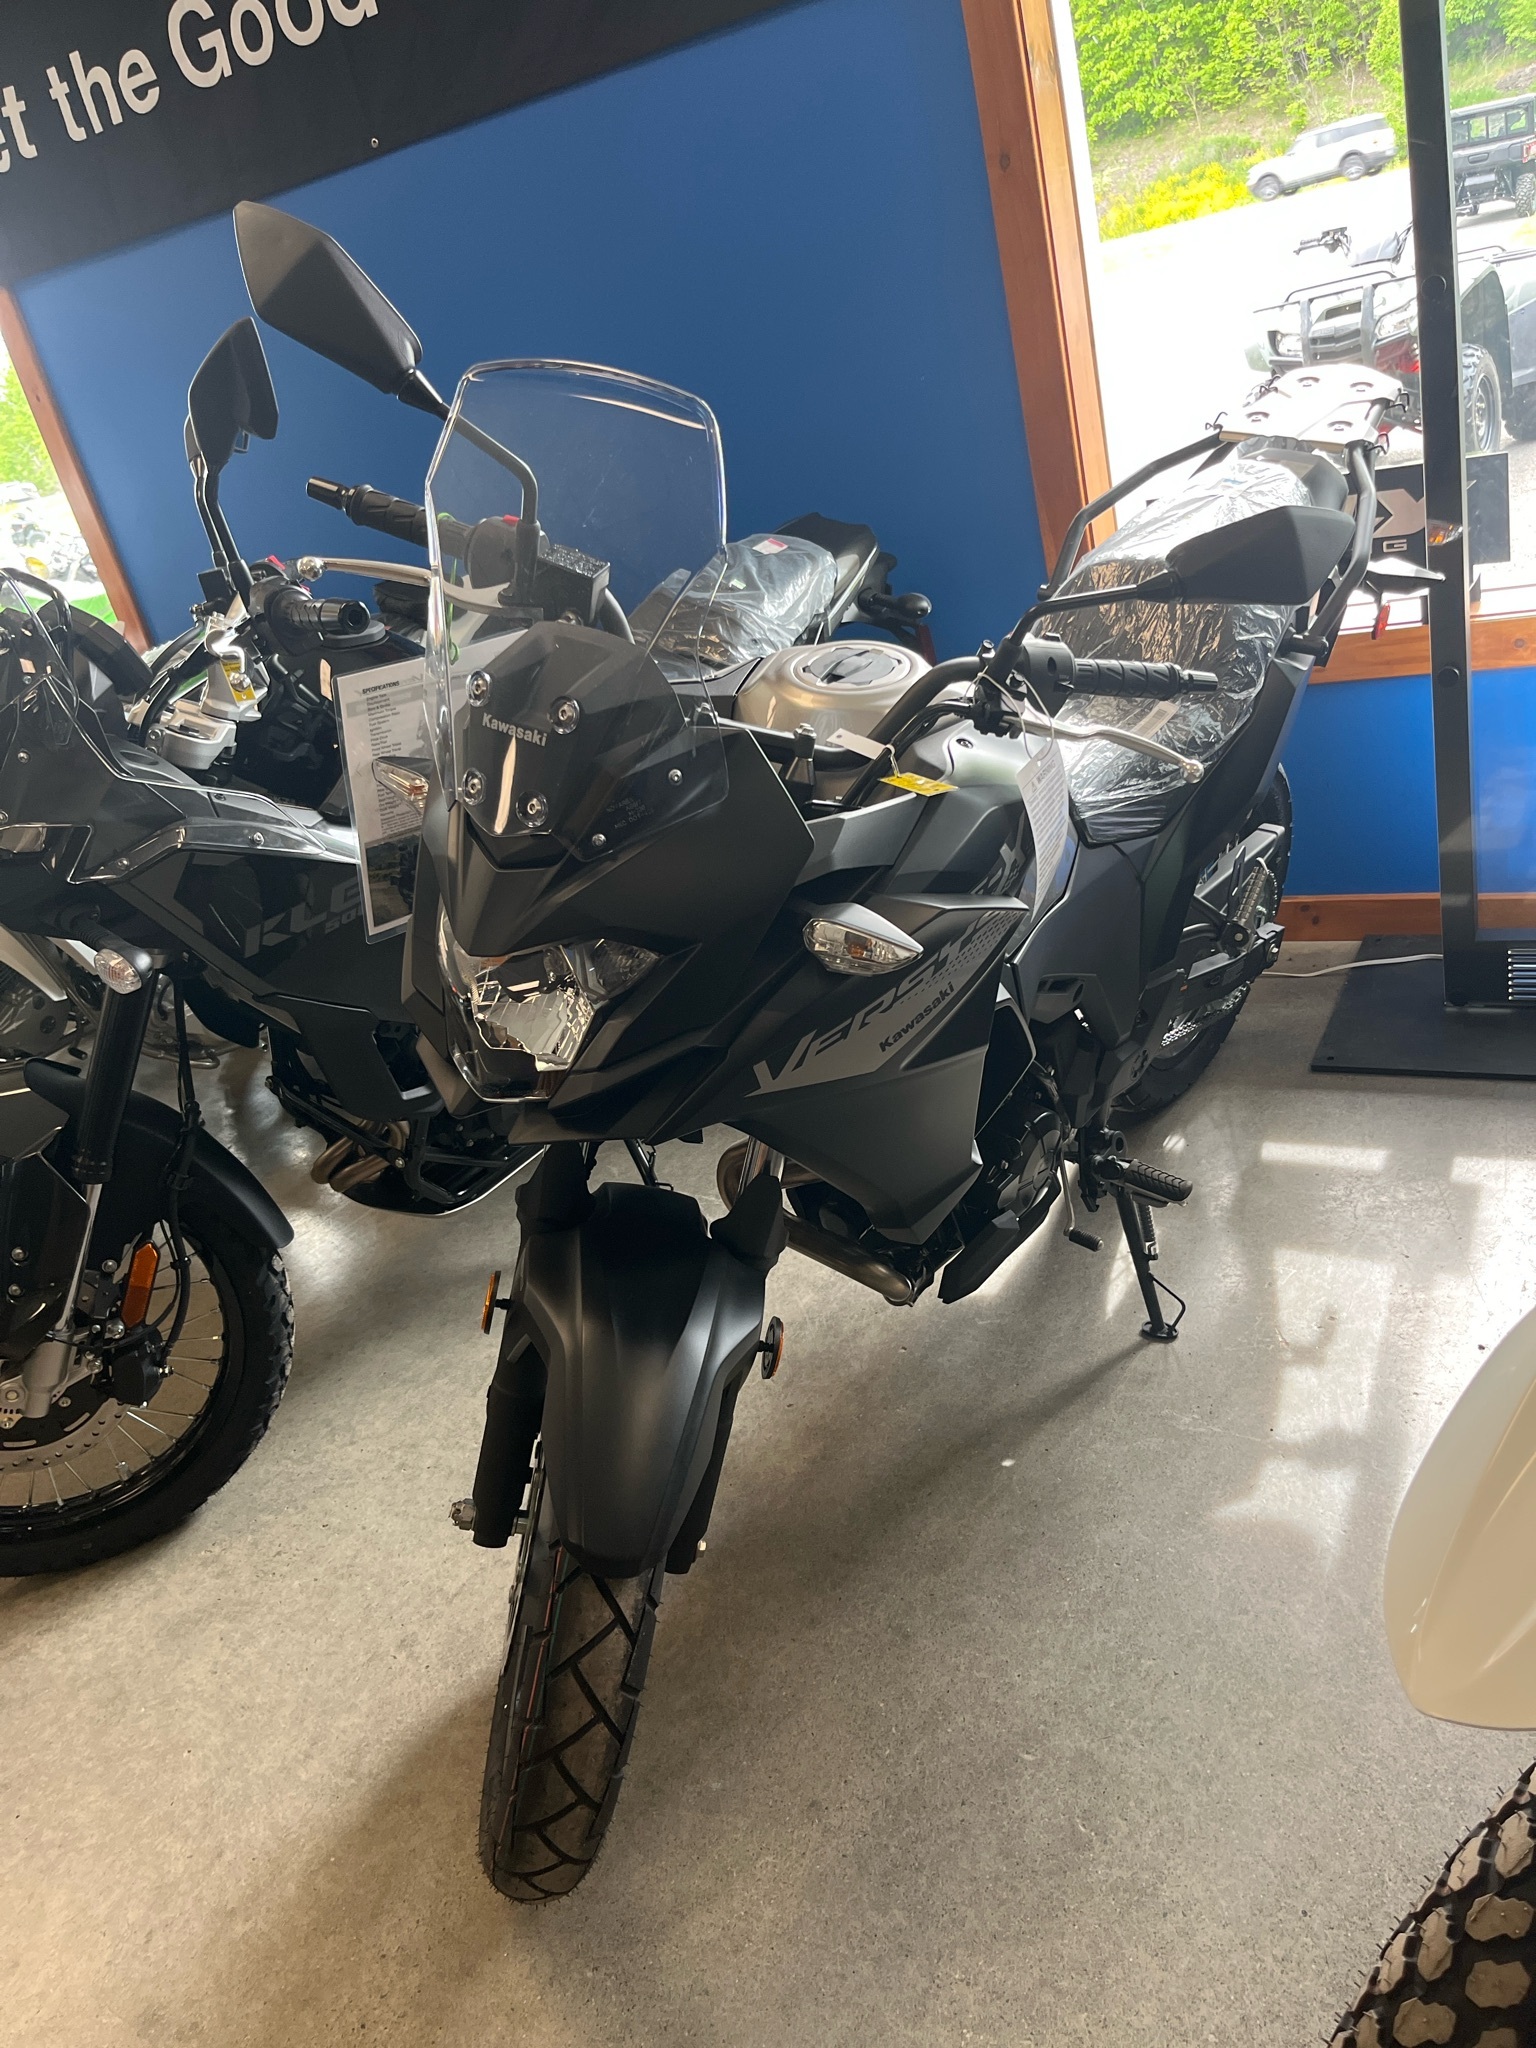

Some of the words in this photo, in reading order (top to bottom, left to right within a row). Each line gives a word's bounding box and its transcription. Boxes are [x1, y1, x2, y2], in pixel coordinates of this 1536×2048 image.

[46, 50, 160, 142] the
[482, 712, 548, 747] Kawasaki
[879, 981, 955, 1053] Kawasaki
